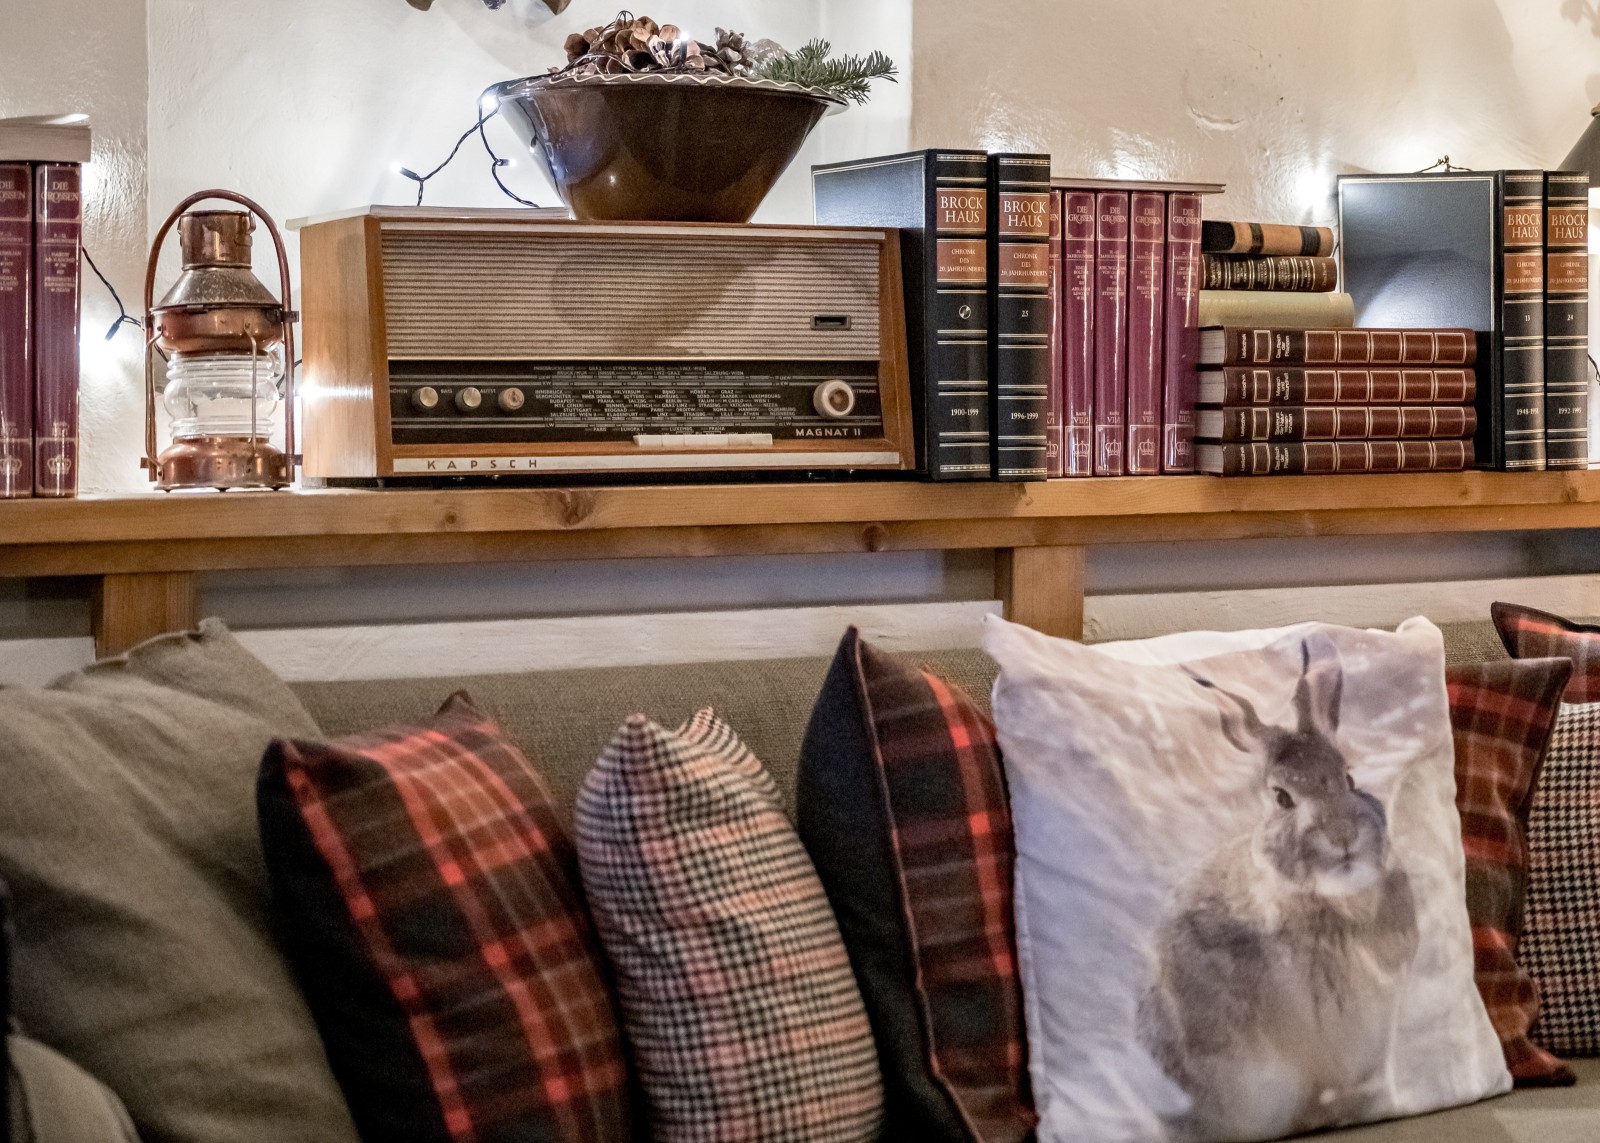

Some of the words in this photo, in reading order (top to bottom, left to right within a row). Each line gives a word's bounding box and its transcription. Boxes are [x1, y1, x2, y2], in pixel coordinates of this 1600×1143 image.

[52, 182, 68, 190] DIE
[41, 192, 78, 203] GROSSEN
[941, 196, 983, 209] BROCK
[1004, 200, 1046, 213] BROCK
[945, 211, 980, 222] HAUS
[1008, 214, 1042, 227] HAUS
[1069, 214, 1093, 224] GROSSEN
[1101, 215, 1126, 224] GROSSEN
[1136, 216, 1161, 226] GROSSEN
[1173, 216, 1200, 226] GROSSEN
[1508, 214, 1541, 225] BROCK
[1552, 214, 1586, 226] BROCK
[1512, 227, 1539, 238] HAUS
[1556, 227, 1584, 239] HAUS
[796, 428, 848, 436] MAGNAT
[854, 428, 860, 436] II
[427, 460, 537, 469] KAPSCH
